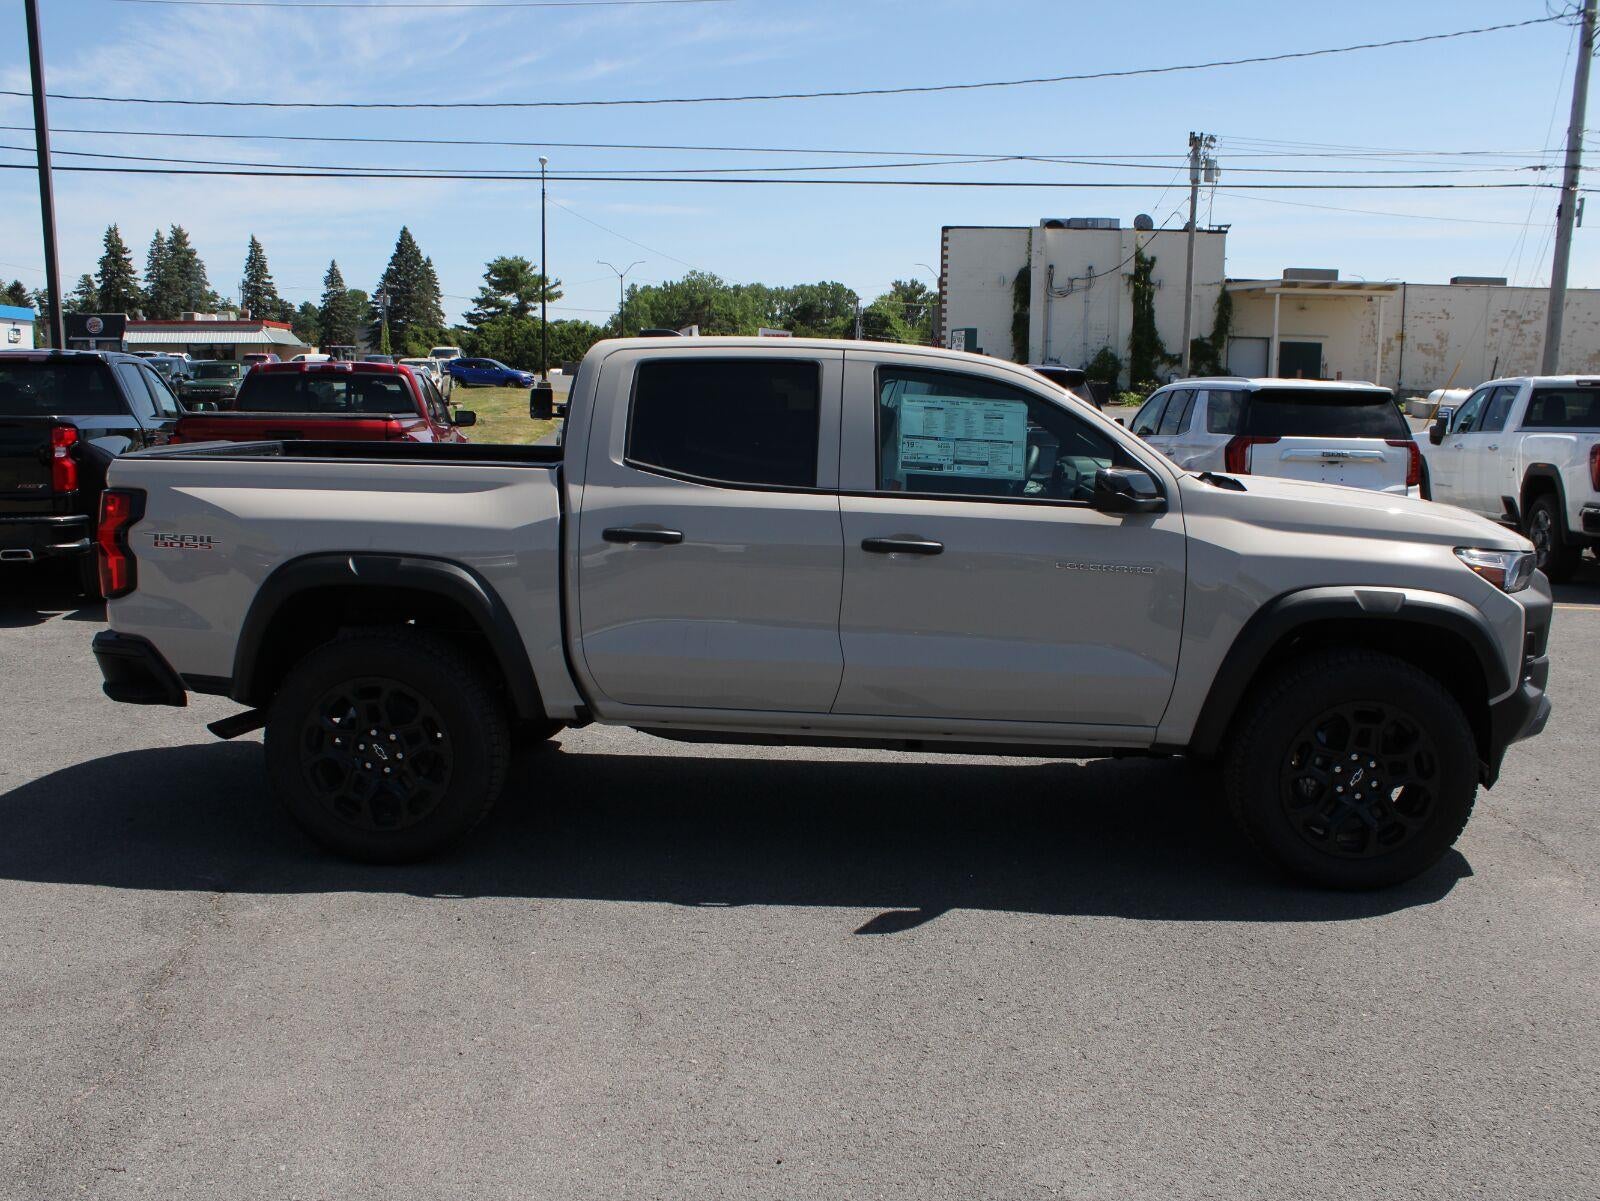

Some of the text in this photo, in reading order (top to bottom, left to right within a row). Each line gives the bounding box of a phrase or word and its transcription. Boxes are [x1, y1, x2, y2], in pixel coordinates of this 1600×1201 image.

[143, 532, 222, 544] TRAIL
[153, 541, 213, 550] BOSS
[1055, 562, 1154, 575] COLORADO
